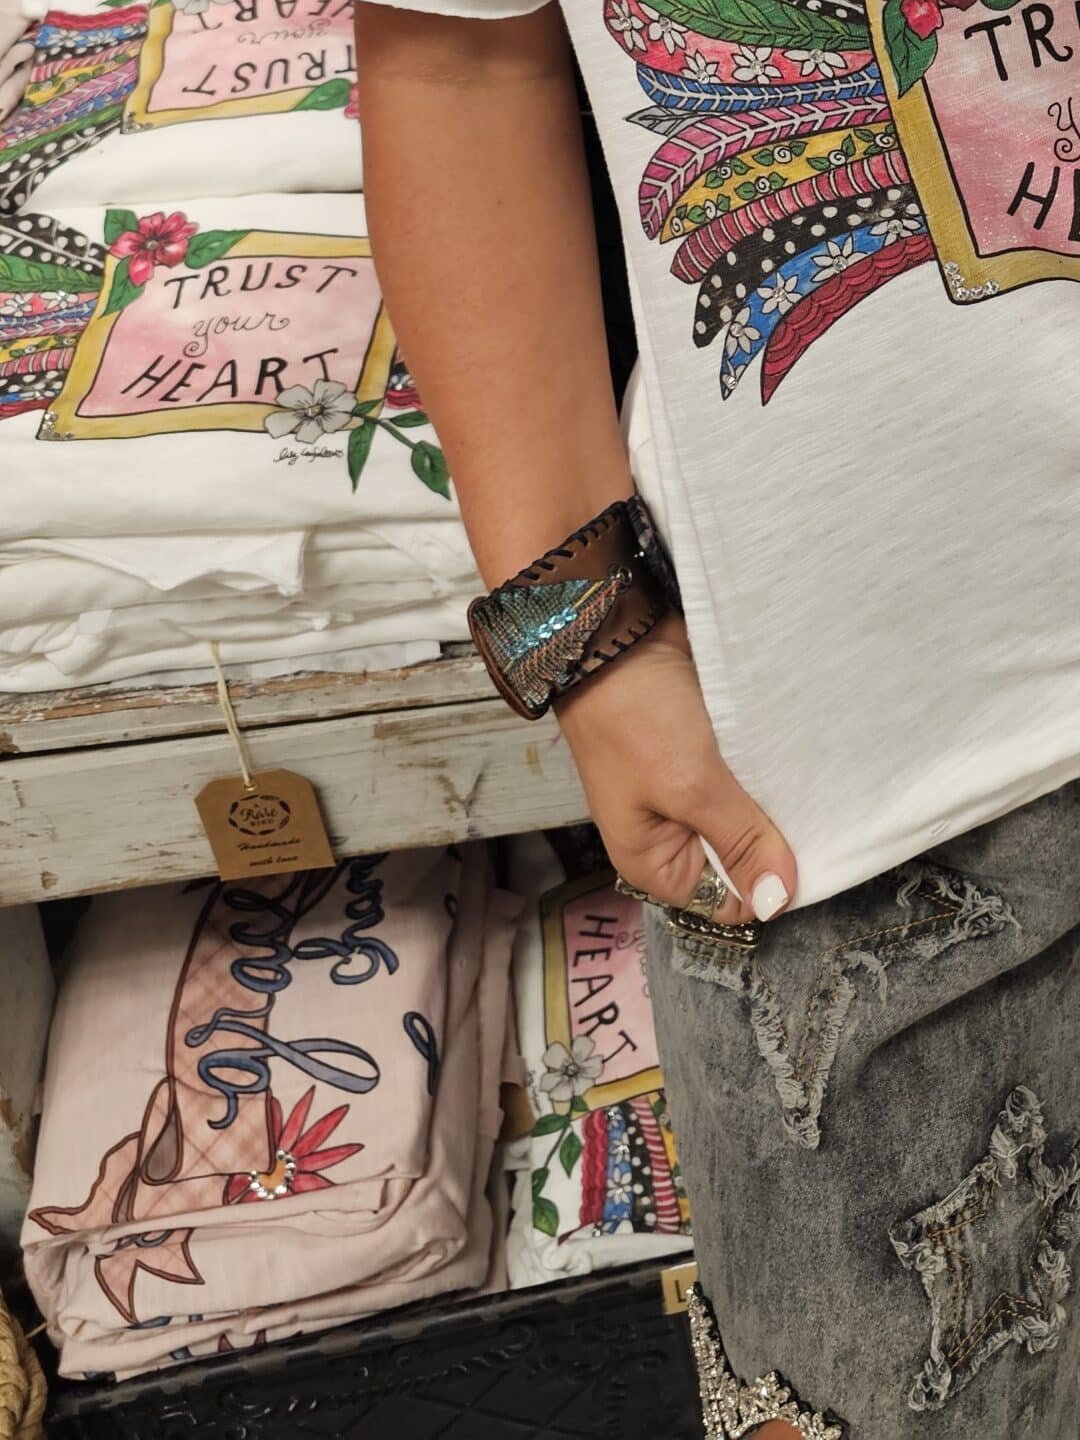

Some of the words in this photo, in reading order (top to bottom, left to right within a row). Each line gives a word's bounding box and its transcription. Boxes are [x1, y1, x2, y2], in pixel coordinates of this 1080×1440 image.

[163, 262, 358, 310] TRUST
[182, 311, 291, 359] your
[120, 347, 339, 403] HEART
[571, 914, 638, 1065] HEART
